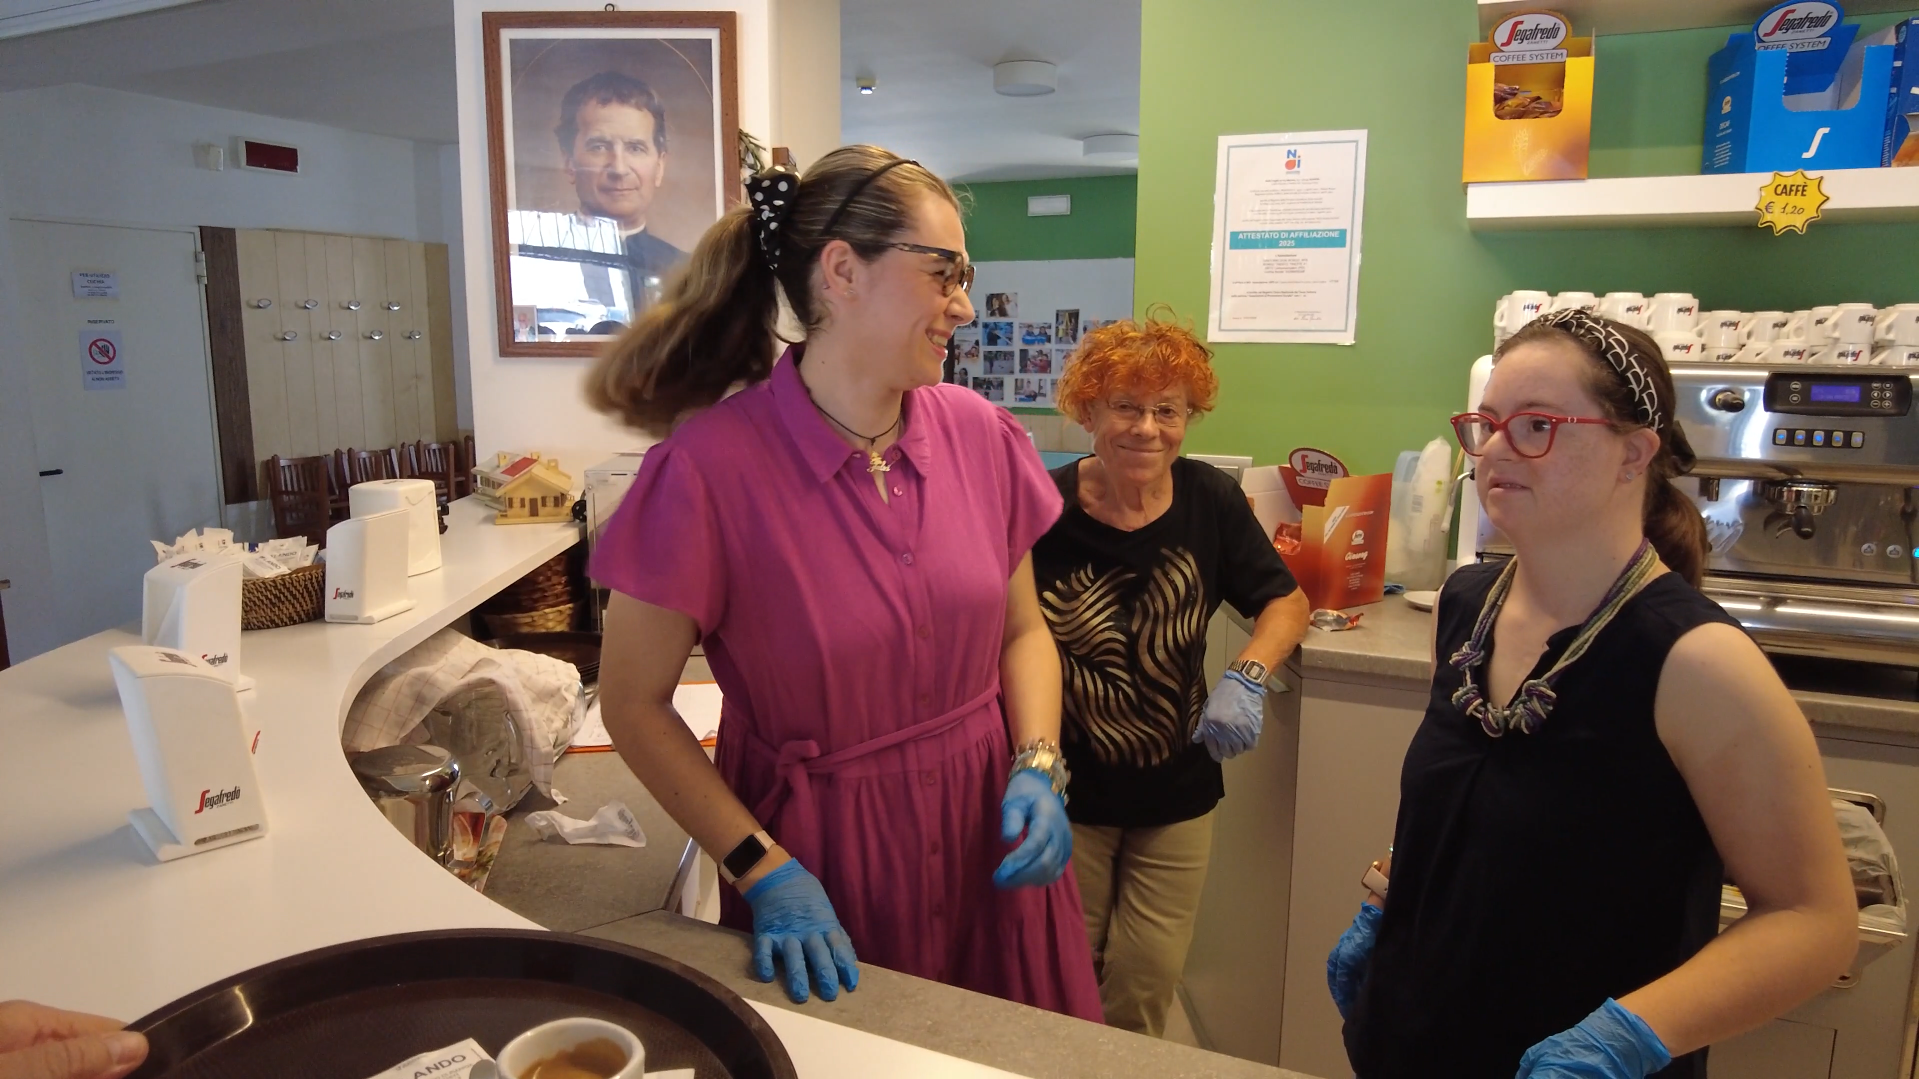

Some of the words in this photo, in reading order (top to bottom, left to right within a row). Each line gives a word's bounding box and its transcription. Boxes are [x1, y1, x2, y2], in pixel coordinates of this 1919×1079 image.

[1762, 8, 1833, 38] Segafredo
[1500, 20, 1561, 47] Segafredo
[1789, 40, 1828, 50] SYSTEM
[1492, 53, 1527, 63] COFFEE
[1529, 51, 1564, 61] SYSTEM
[1774, 182, 1808, 197] CAFFÈ
[1764, 201, 1776, 214] €
[1300, 454, 1339, 475] Segafredo
[194, 786, 241, 815] Segafredo
